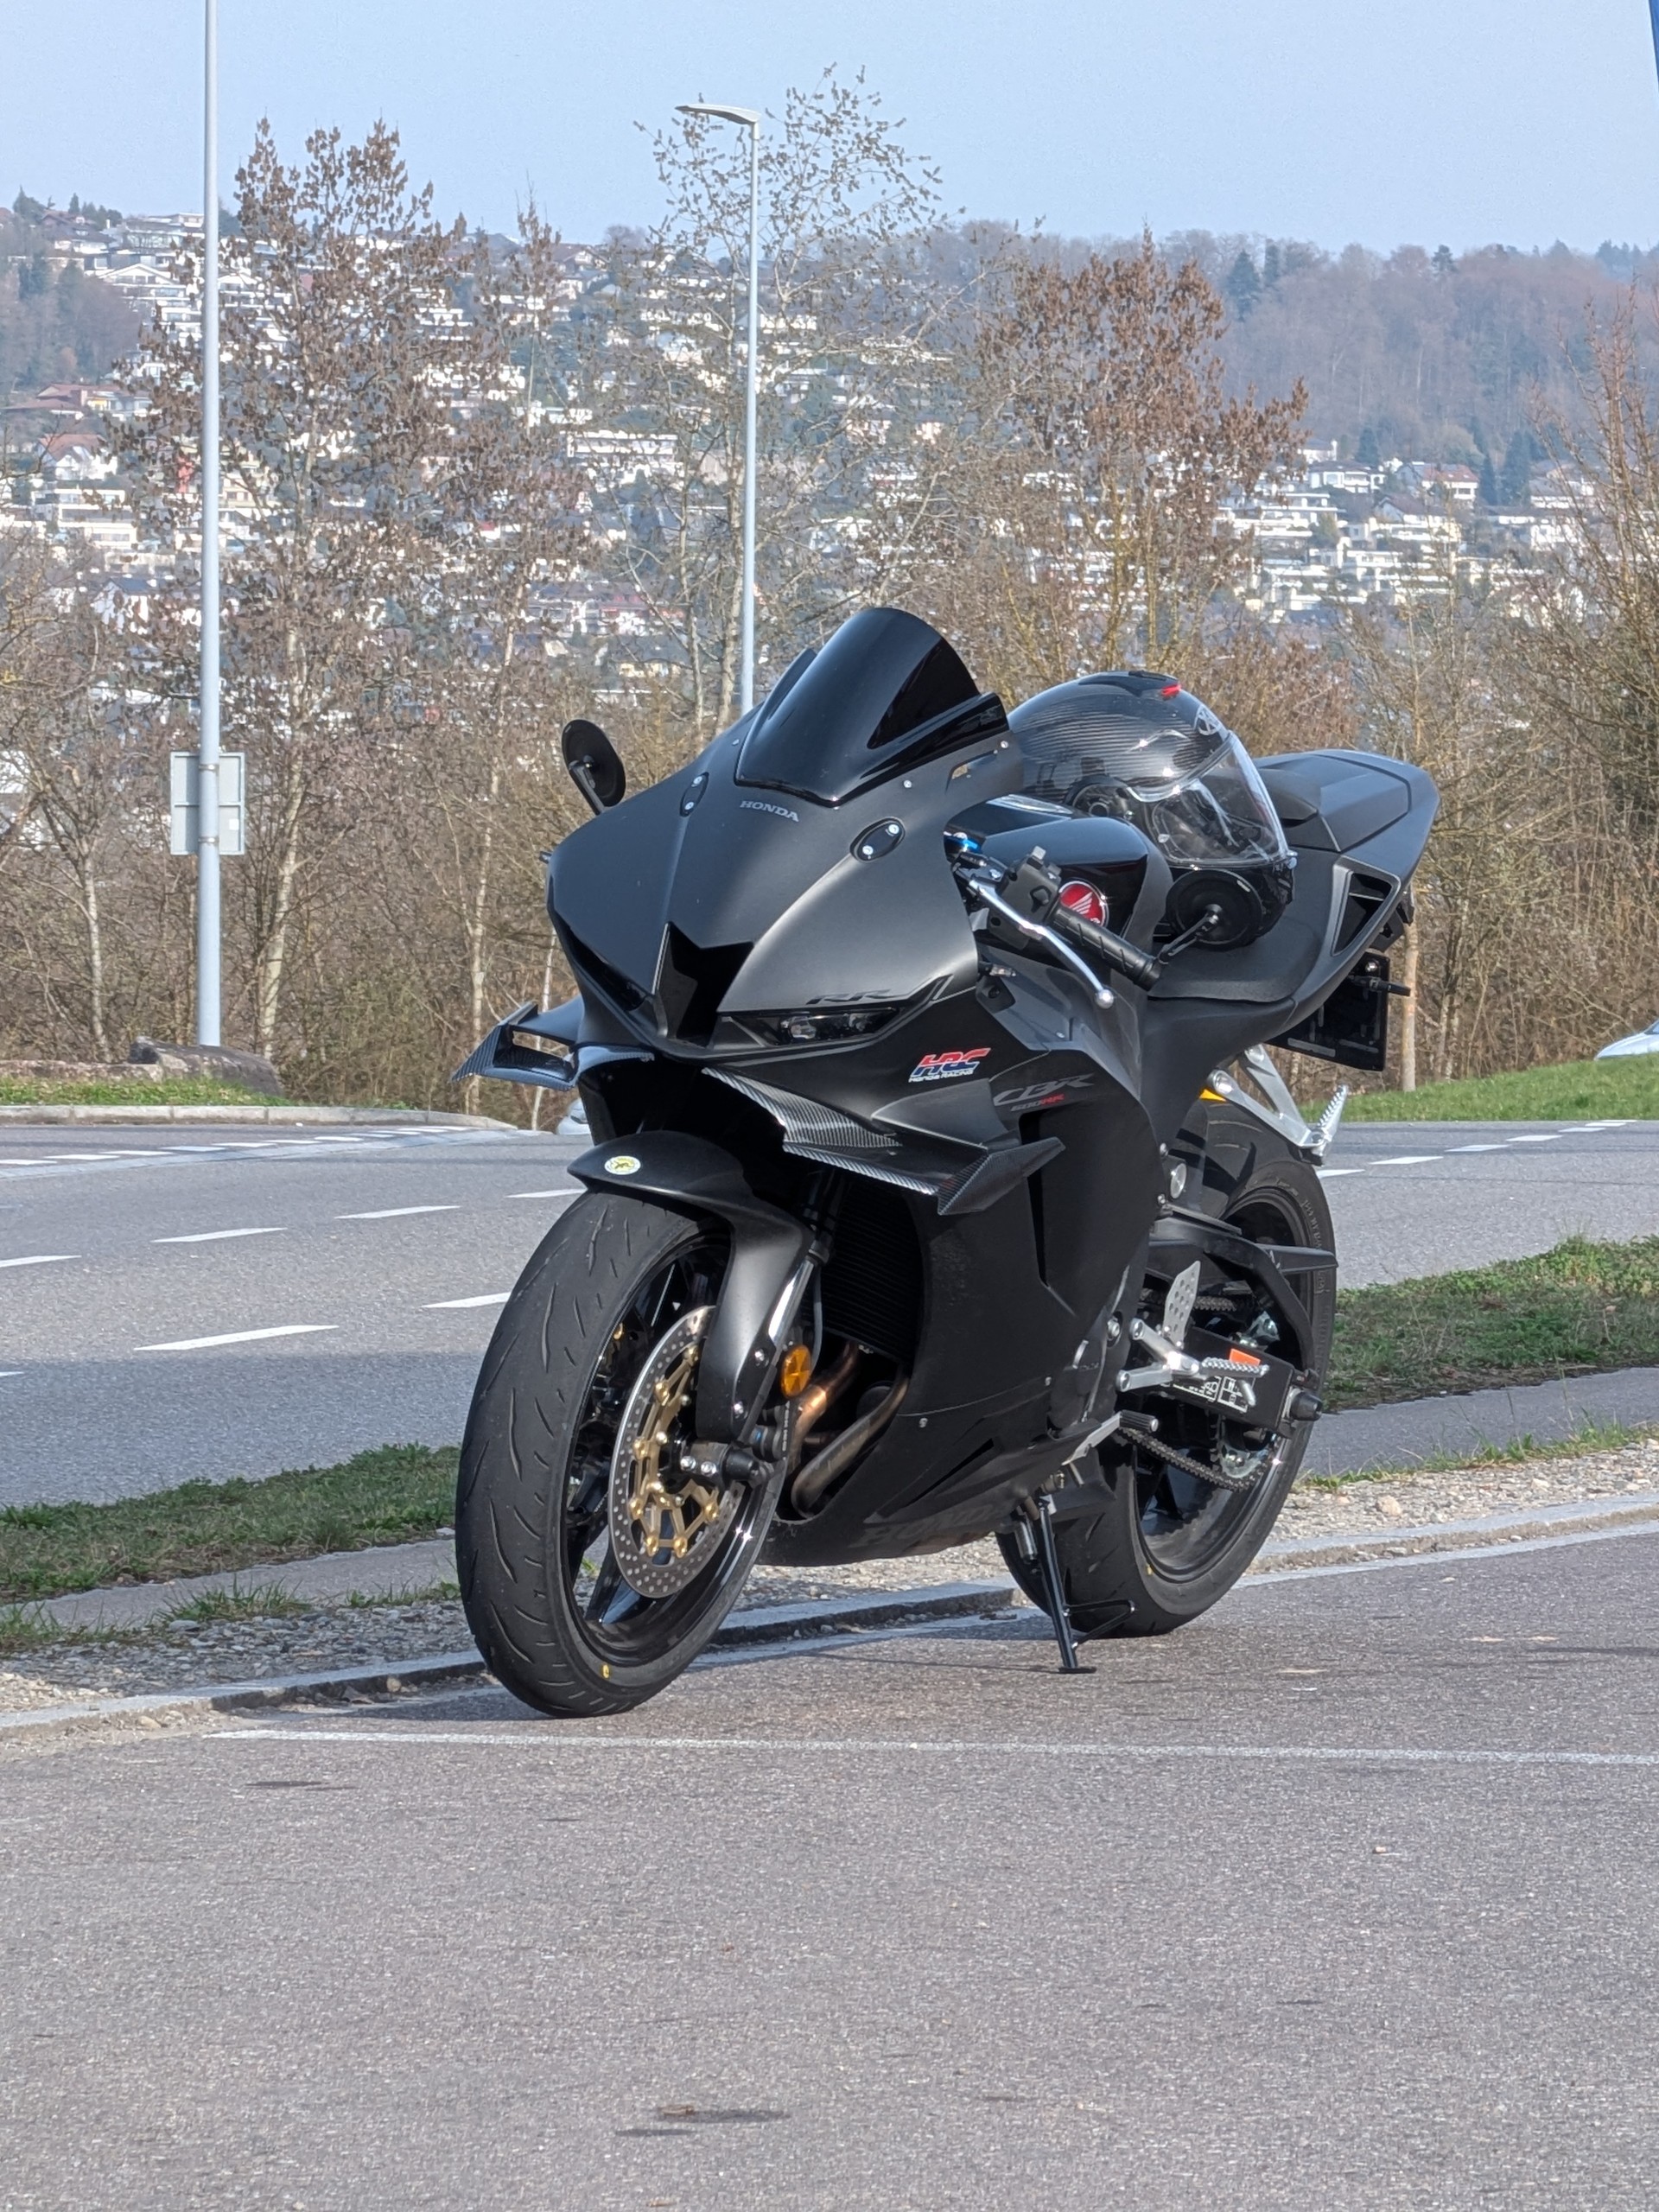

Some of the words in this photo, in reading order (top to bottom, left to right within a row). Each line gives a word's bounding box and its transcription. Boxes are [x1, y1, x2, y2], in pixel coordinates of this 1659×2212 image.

[739, 800, 799, 823] HONDA
[910, 1047, 991, 1077] HRC
[940, 1069, 975, 1078] RACING
[993, 1072, 1095, 1106] CBR
